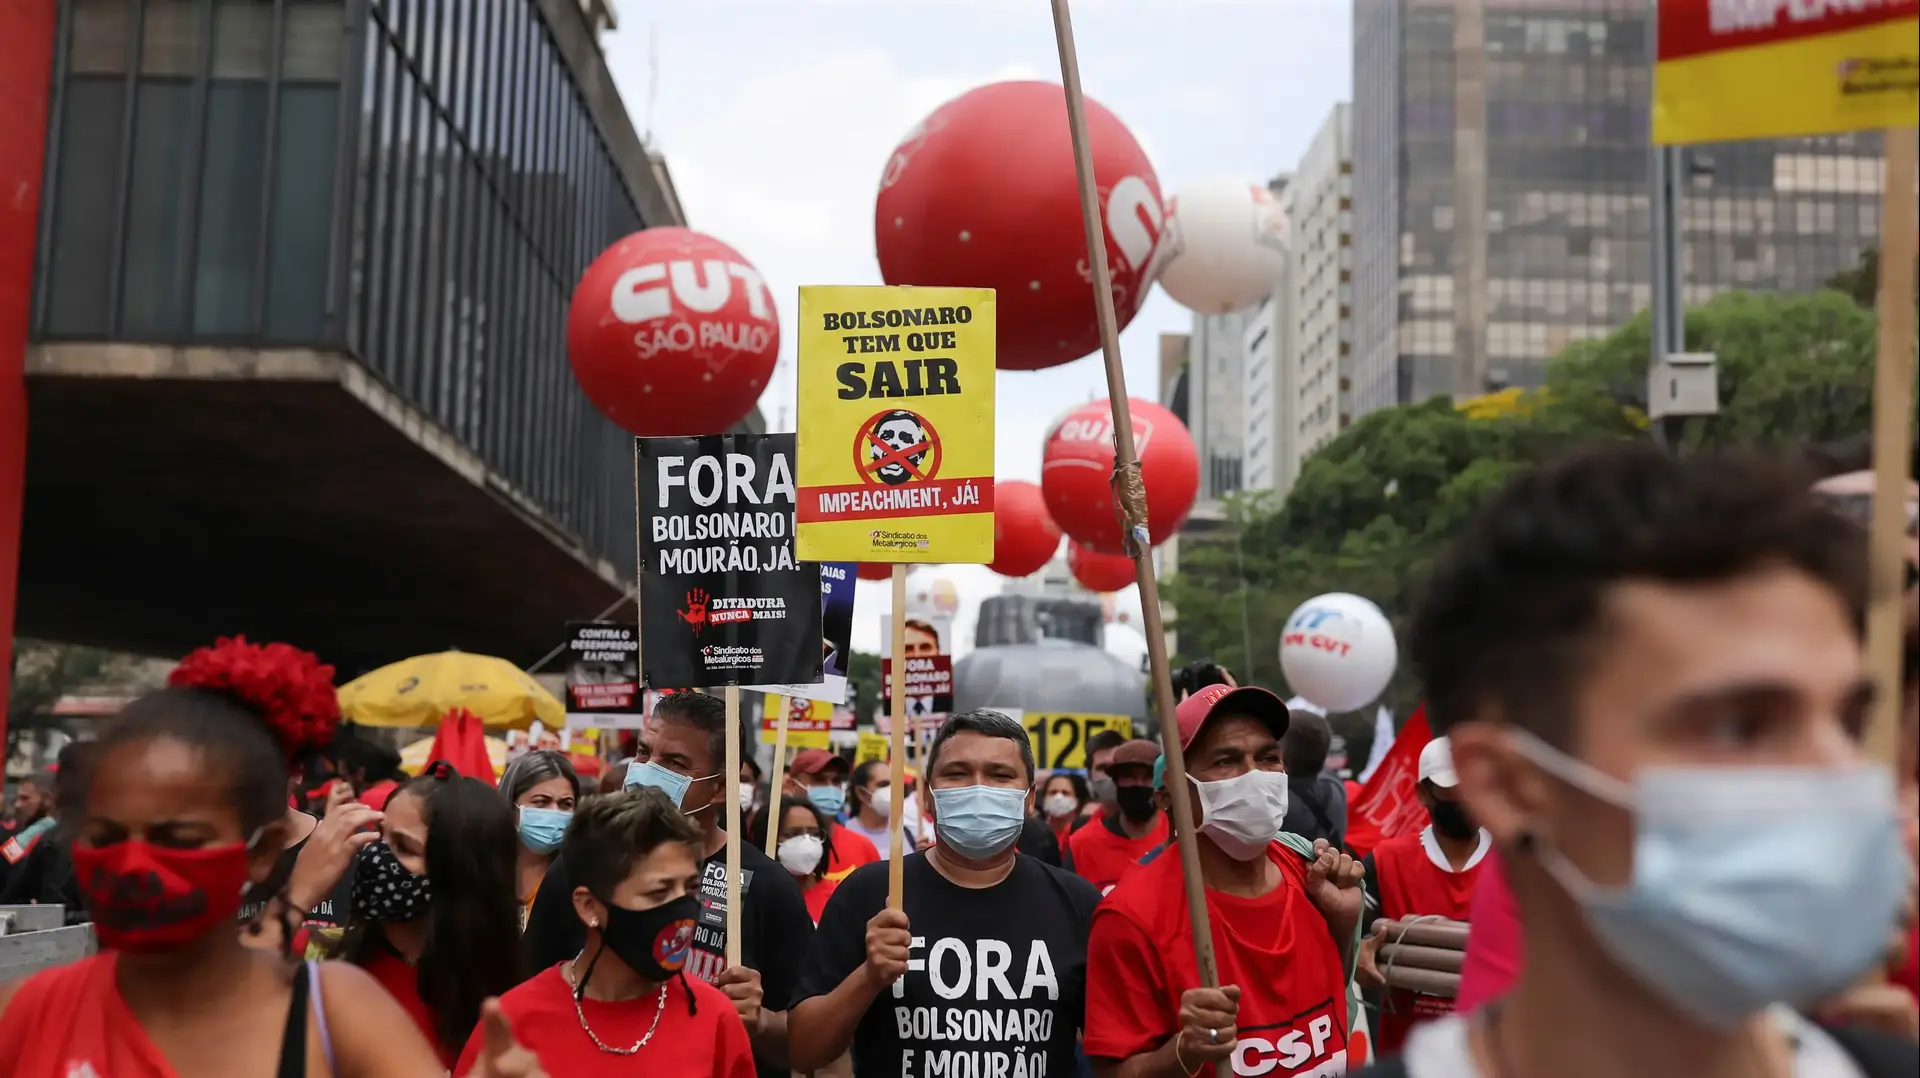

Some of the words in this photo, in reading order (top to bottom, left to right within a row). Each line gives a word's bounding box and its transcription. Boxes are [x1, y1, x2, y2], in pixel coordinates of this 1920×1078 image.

[611, 260, 771, 323] CUT
[823, 306, 972, 331] BOLSONARO
[634, 319, 695, 359] SÃO
[700, 321, 769, 354] PAULO
[843, 334, 900, 354] TEM
[906, 331, 956, 352] QUE
[836, 358, 961, 400] SAIR
[657, 453, 796, 508] FORA
[819, 487, 948, 513] IMPEACHMENT,
[952, 479, 979, 505] JÁ!
[652, 512, 785, 542] BOLSONARO
[882, 531, 915, 539] Sindicato
[872, 539, 918, 549] Metalúrgicos
[712, 597, 786, 610] DITADURA
[711, 611, 750, 622] NUNCA
[752, 610, 786, 620] MAIS!
[570, 640, 638, 651] DESEMPREGO
[579, 629, 620, 639] CONTRA
[704, 654, 751, 665] Metalúrgicos
[713, 646, 749, 655] Sindicato
[904, 658, 935, 672] ORA
[704, 862, 745, 885] FOA
[710, 932, 725, 949] DÁ
[892, 936, 1059, 1001] FORA
[894, 1006, 1054, 1042] BOLSONARO
[1230, 1014, 1332, 1077] CSP
[901, 1049, 915, 1078] E
